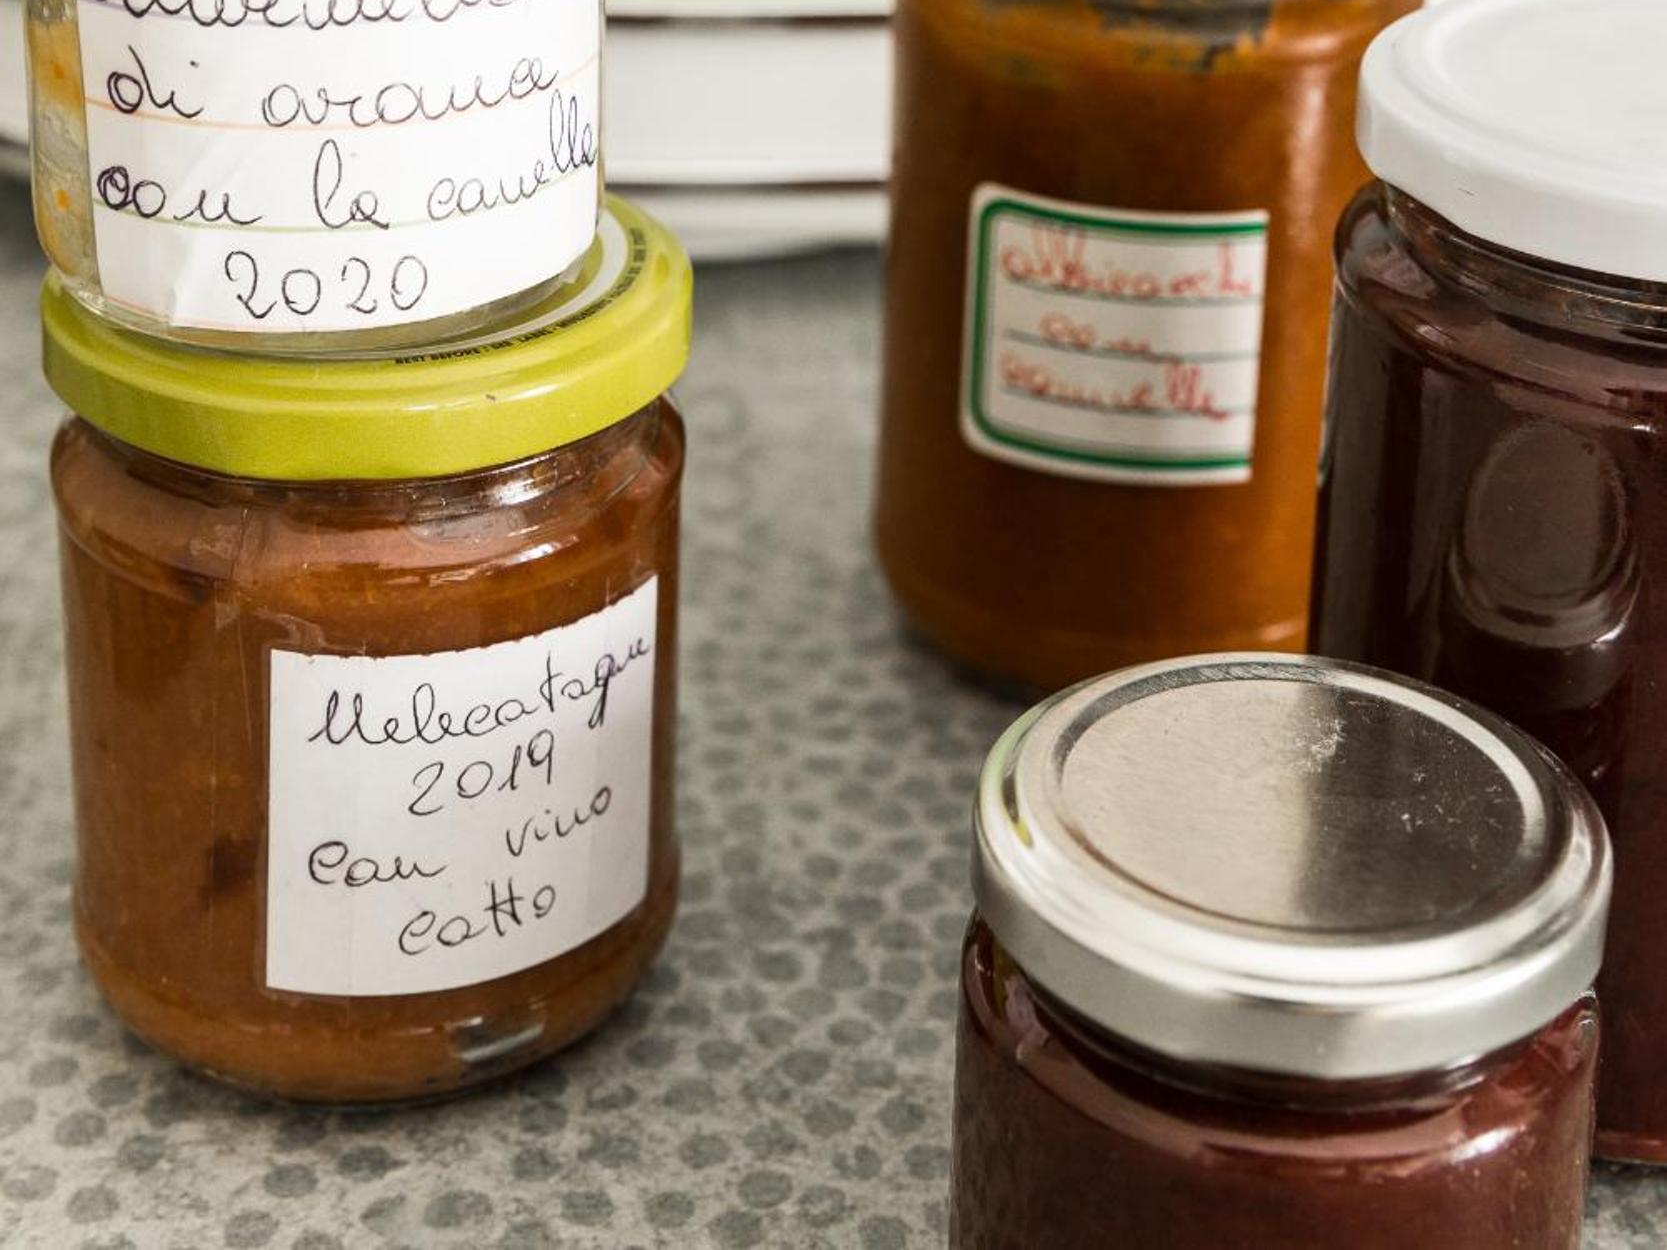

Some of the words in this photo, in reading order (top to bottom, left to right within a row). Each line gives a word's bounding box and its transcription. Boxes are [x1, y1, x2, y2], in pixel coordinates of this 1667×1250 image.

[106, 45, 204, 118] di
[224, 250, 429, 319] 2020
[408, 728, 555, 816] 2019
[506, 786, 612, 857] vino
